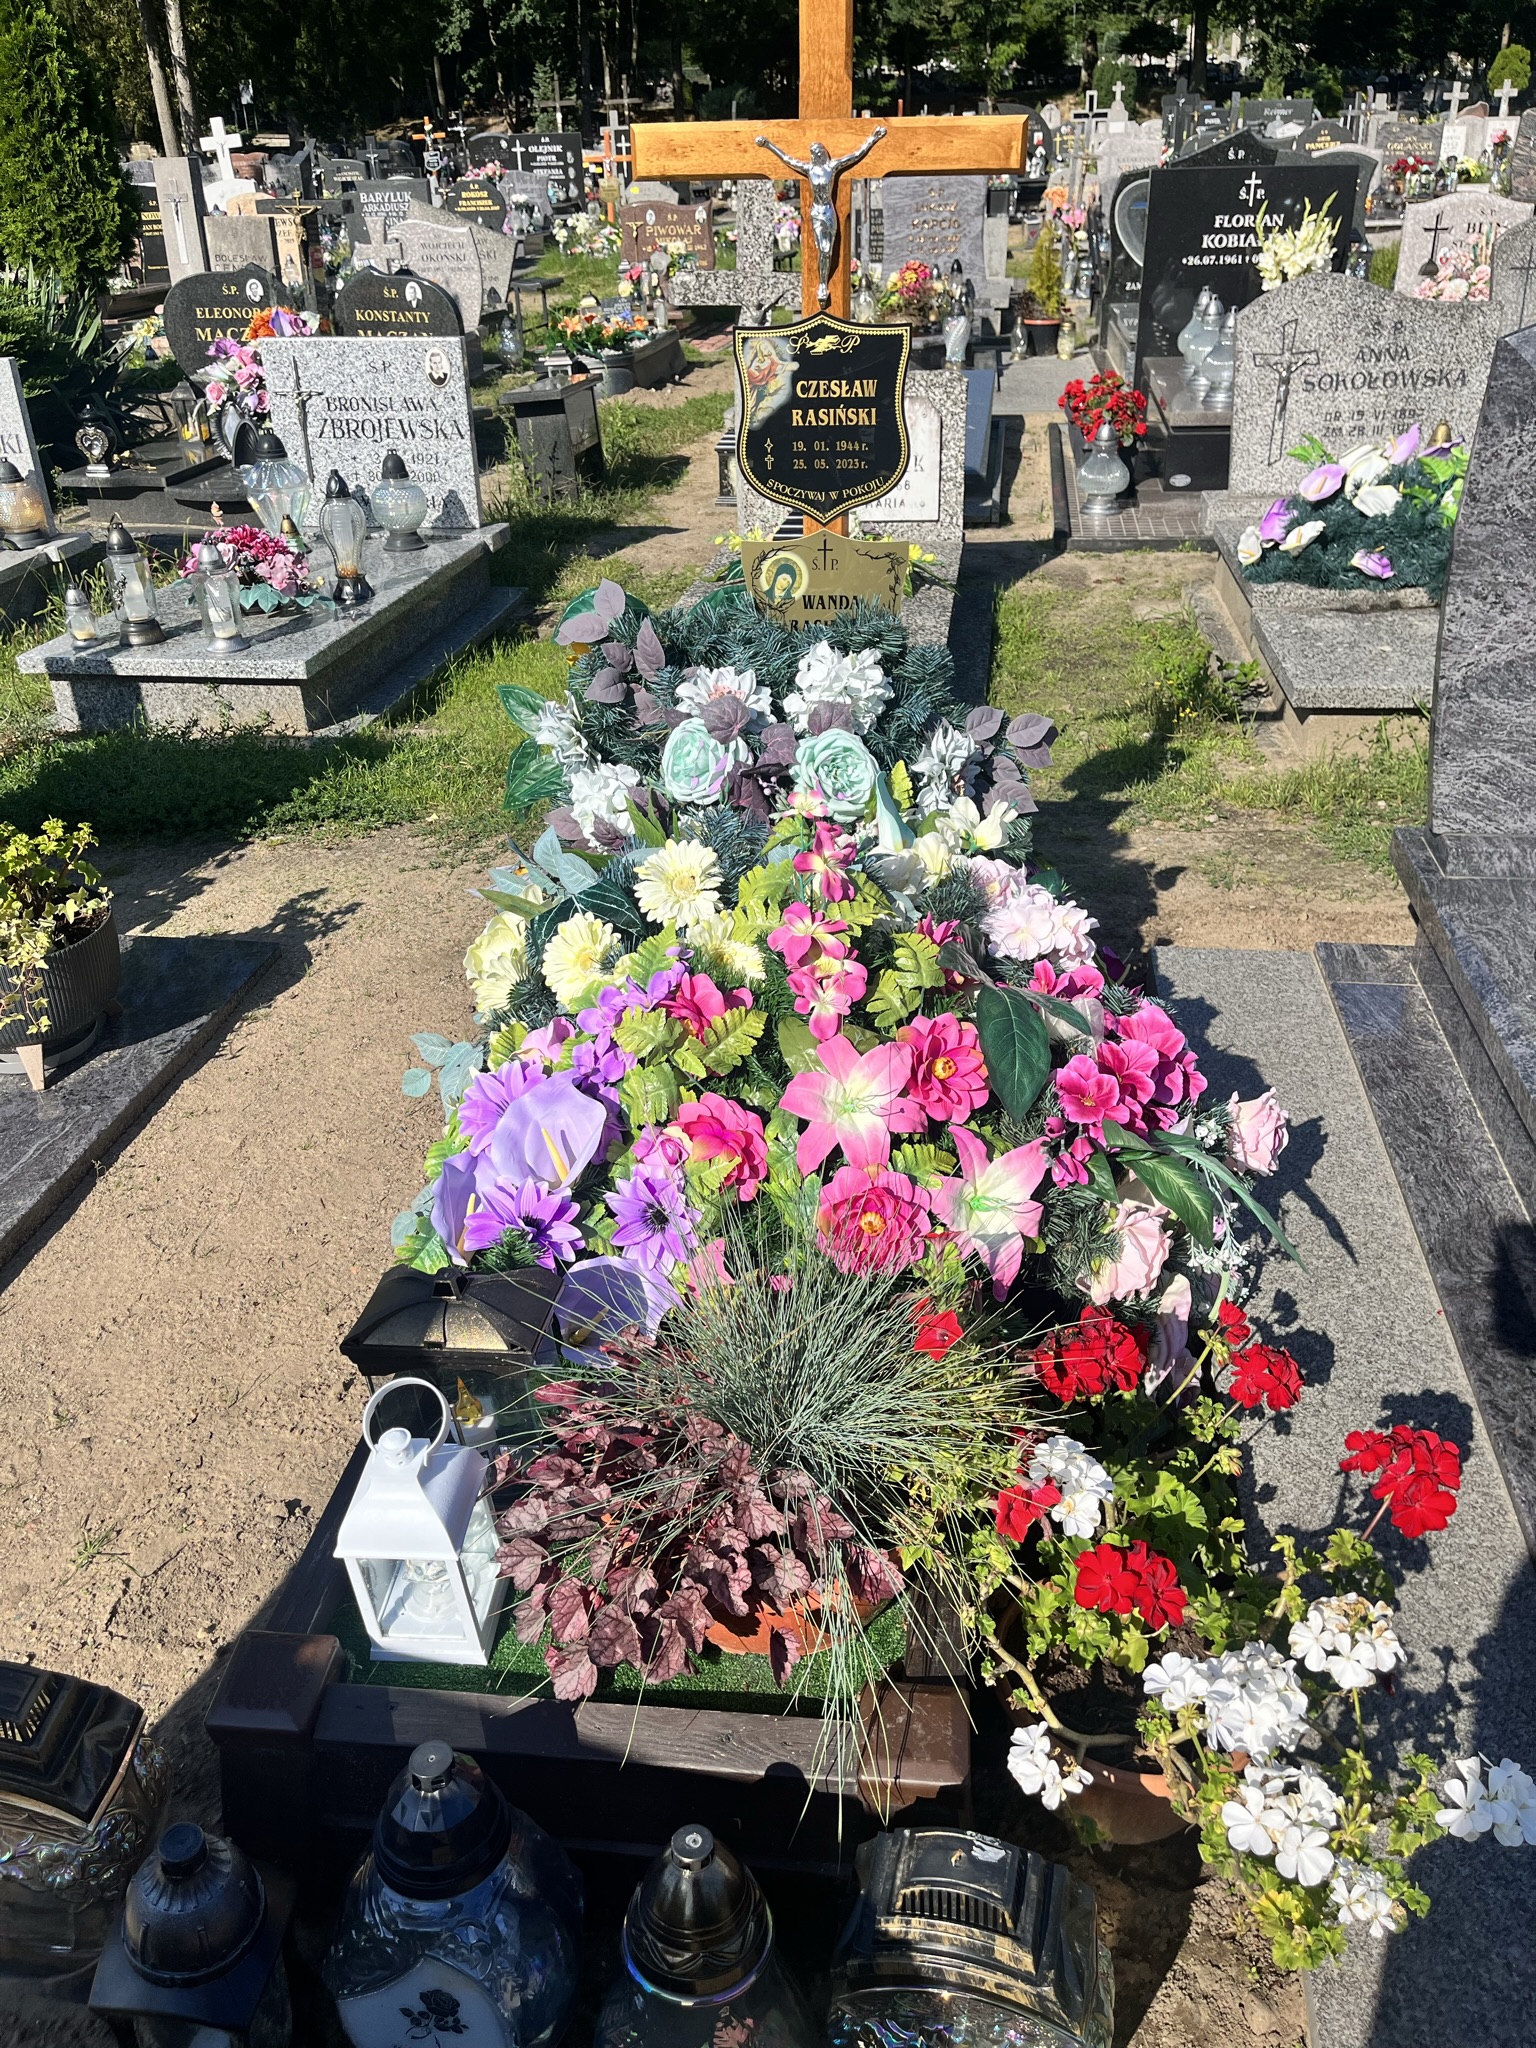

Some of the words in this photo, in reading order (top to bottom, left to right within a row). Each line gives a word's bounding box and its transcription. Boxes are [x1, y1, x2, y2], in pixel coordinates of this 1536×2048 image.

[528, 145, 564, 154] OLEJNIK
[360, 191, 412, 203] BARYLUK
[461, 190, 489, 199] ROKOSZ
[362, 203, 409, 212] ARKADIUSZ
[1214, 213, 1285, 229] FLORAN
[645, 225, 702, 236] PIWOWAR
[420, 241, 466, 250] WOJCIECH
[195, 307, 261, 319] ELEONOR
[354, 309, 431, 324] KONSTANTY
[194, 327, 251, 343] MACZ
[1354, 344, 1412, 363] ANNA
[795, 379, 878, 398] CZESŁAW
[1301, 368, 1469, 394] SOKOŁOWSKA
[325, 395, 441, 412] BRONISŁAWA
[791, 403, 877, 427] RASIŃSKI
[317, 417, 466, 444] ZBROJEWSKA
[792, 440, 807, 452] 19.
[813, 440, 830, 451] 01.
[835, 440, 860, 451] 1944
[792, 458, 808, 470] 25.
[813, 458, 830, 470] 05.
[835, 458, 860, 470] 2023
[766, 478, 827, 503] SPOCZYWAJ
[828, 490, 840, 501] W
[843, 476, 886, 499] POKOJU
[801, 594, 861, 610] WANDA
